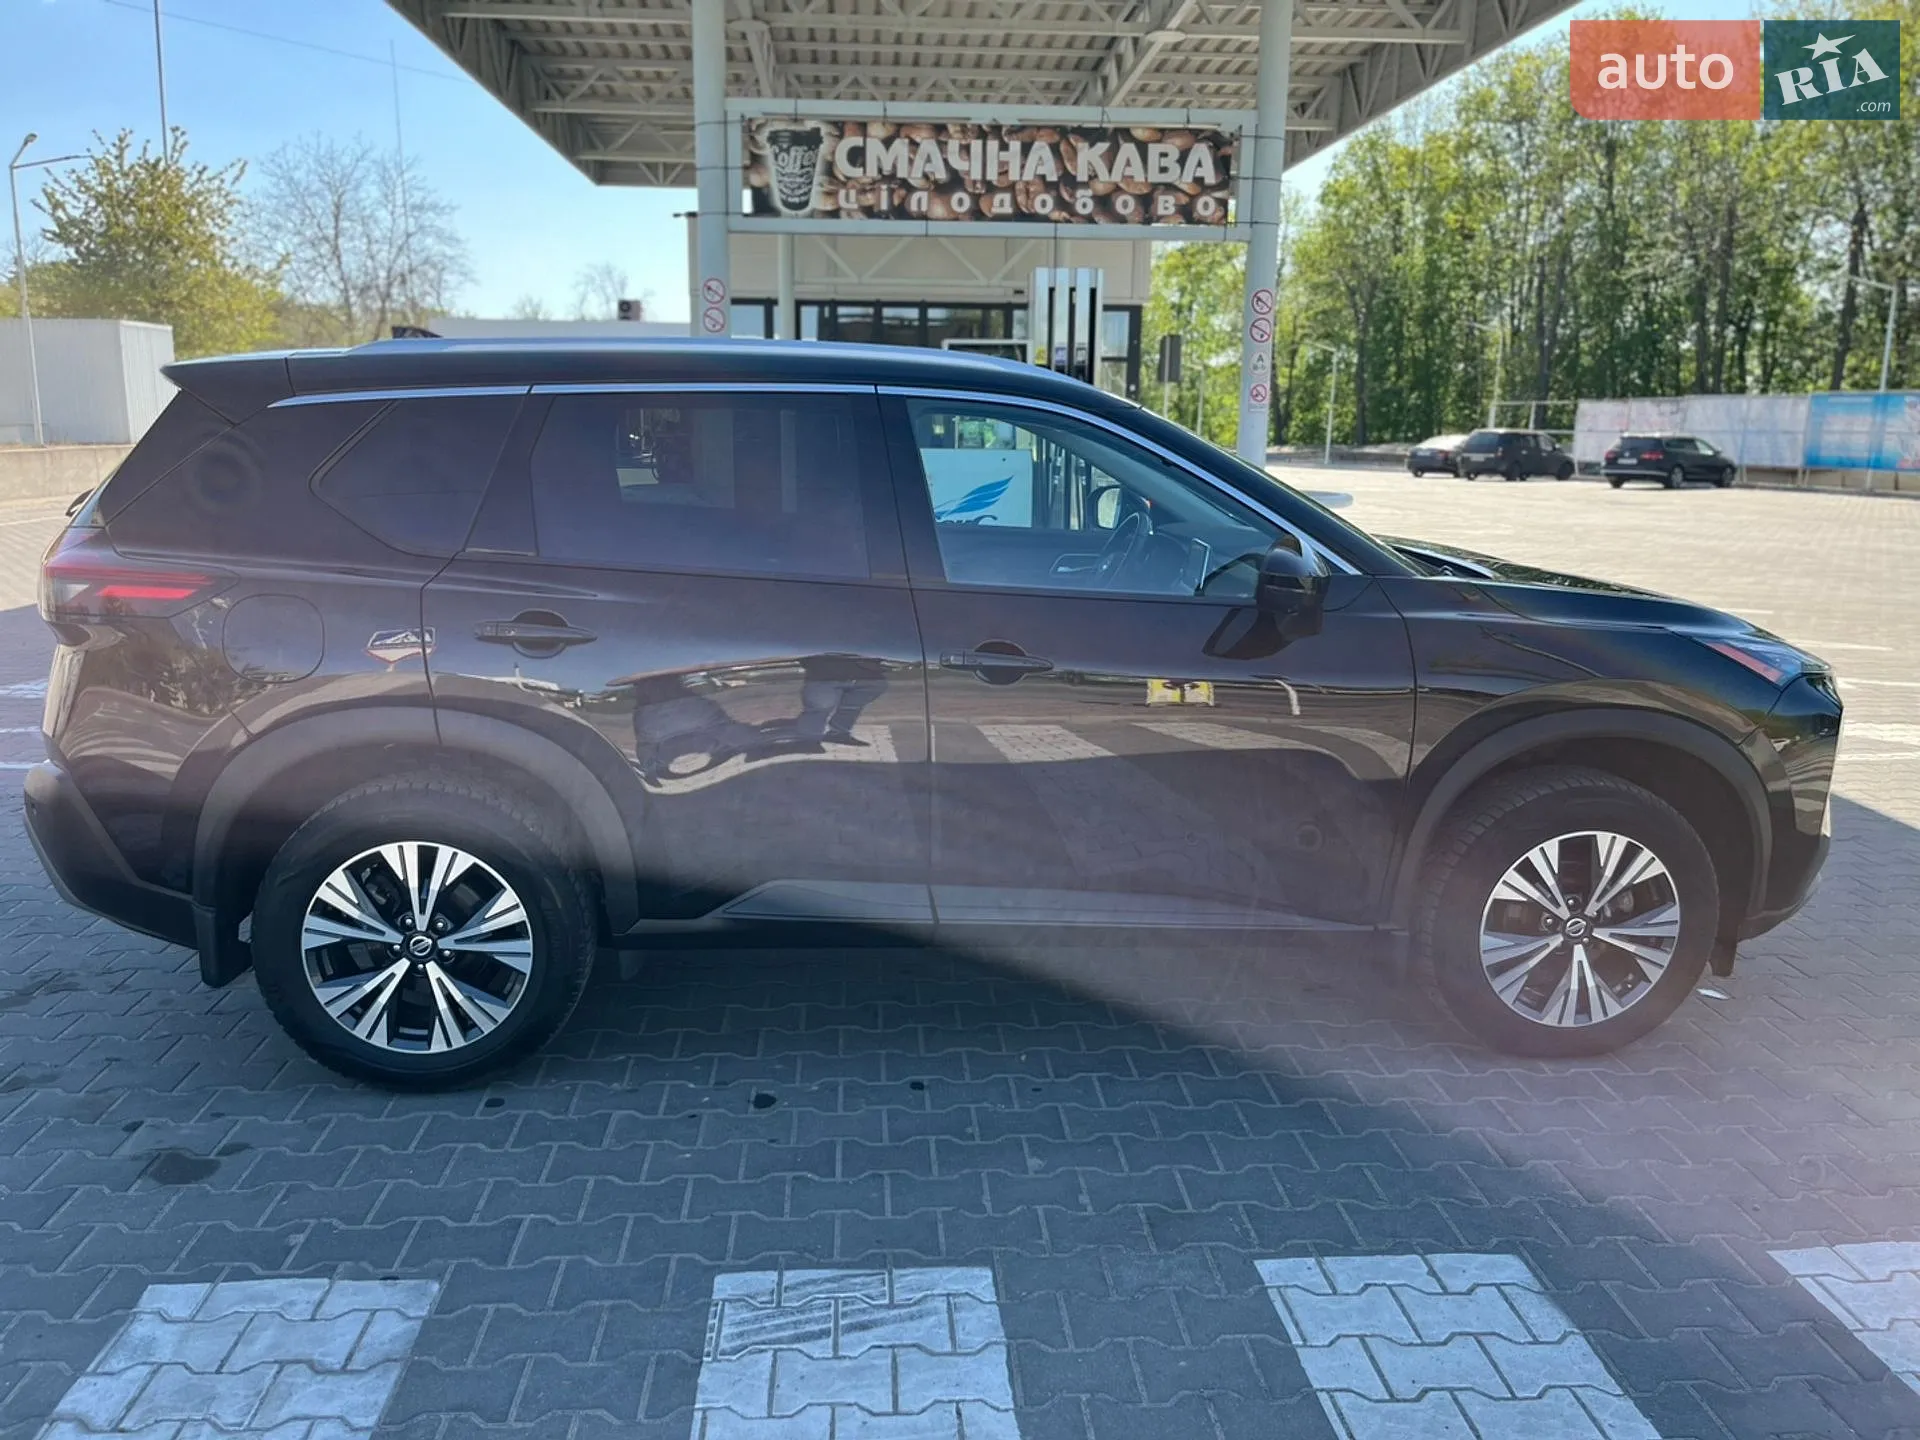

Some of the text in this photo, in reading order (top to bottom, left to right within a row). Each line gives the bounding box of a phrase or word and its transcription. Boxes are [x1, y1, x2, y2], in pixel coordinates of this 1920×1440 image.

[835, 136, 1217, 185] СМАЧНА КАВА
[838, 184, 1217, 217] цілодобово
